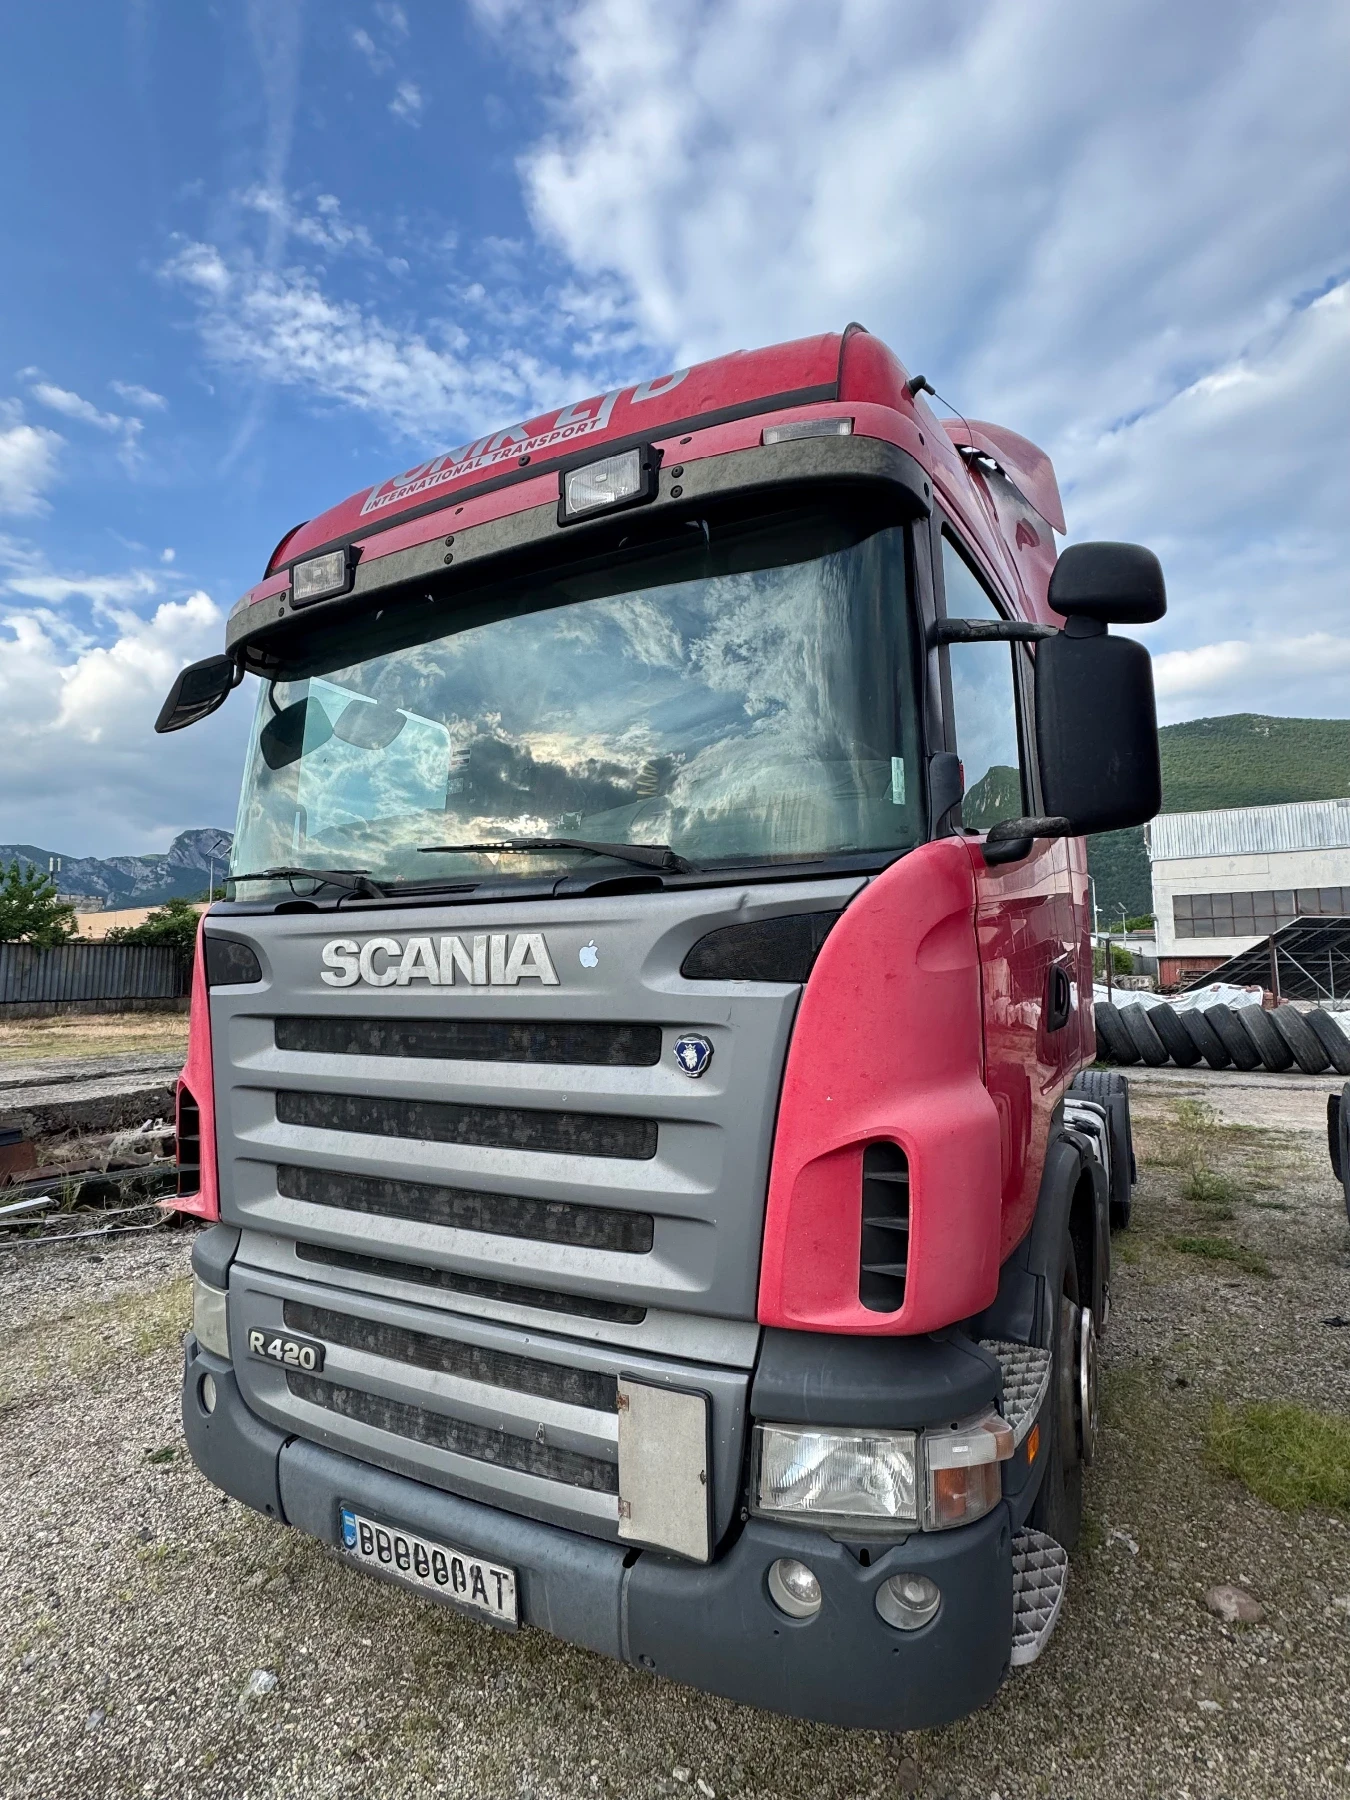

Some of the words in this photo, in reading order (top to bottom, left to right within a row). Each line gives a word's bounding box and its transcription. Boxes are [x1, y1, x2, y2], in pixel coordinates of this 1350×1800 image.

[554, 368, 690, 428] LTD
[365, 457, 483, 511] INTERNATIONAL
[492, 418, 602, 461] TRANSPORT
[320, 933, 560, 987] SCANIA
[250, 1331, 266, 1356] R
[267, 1338, 316, 1370] 420
